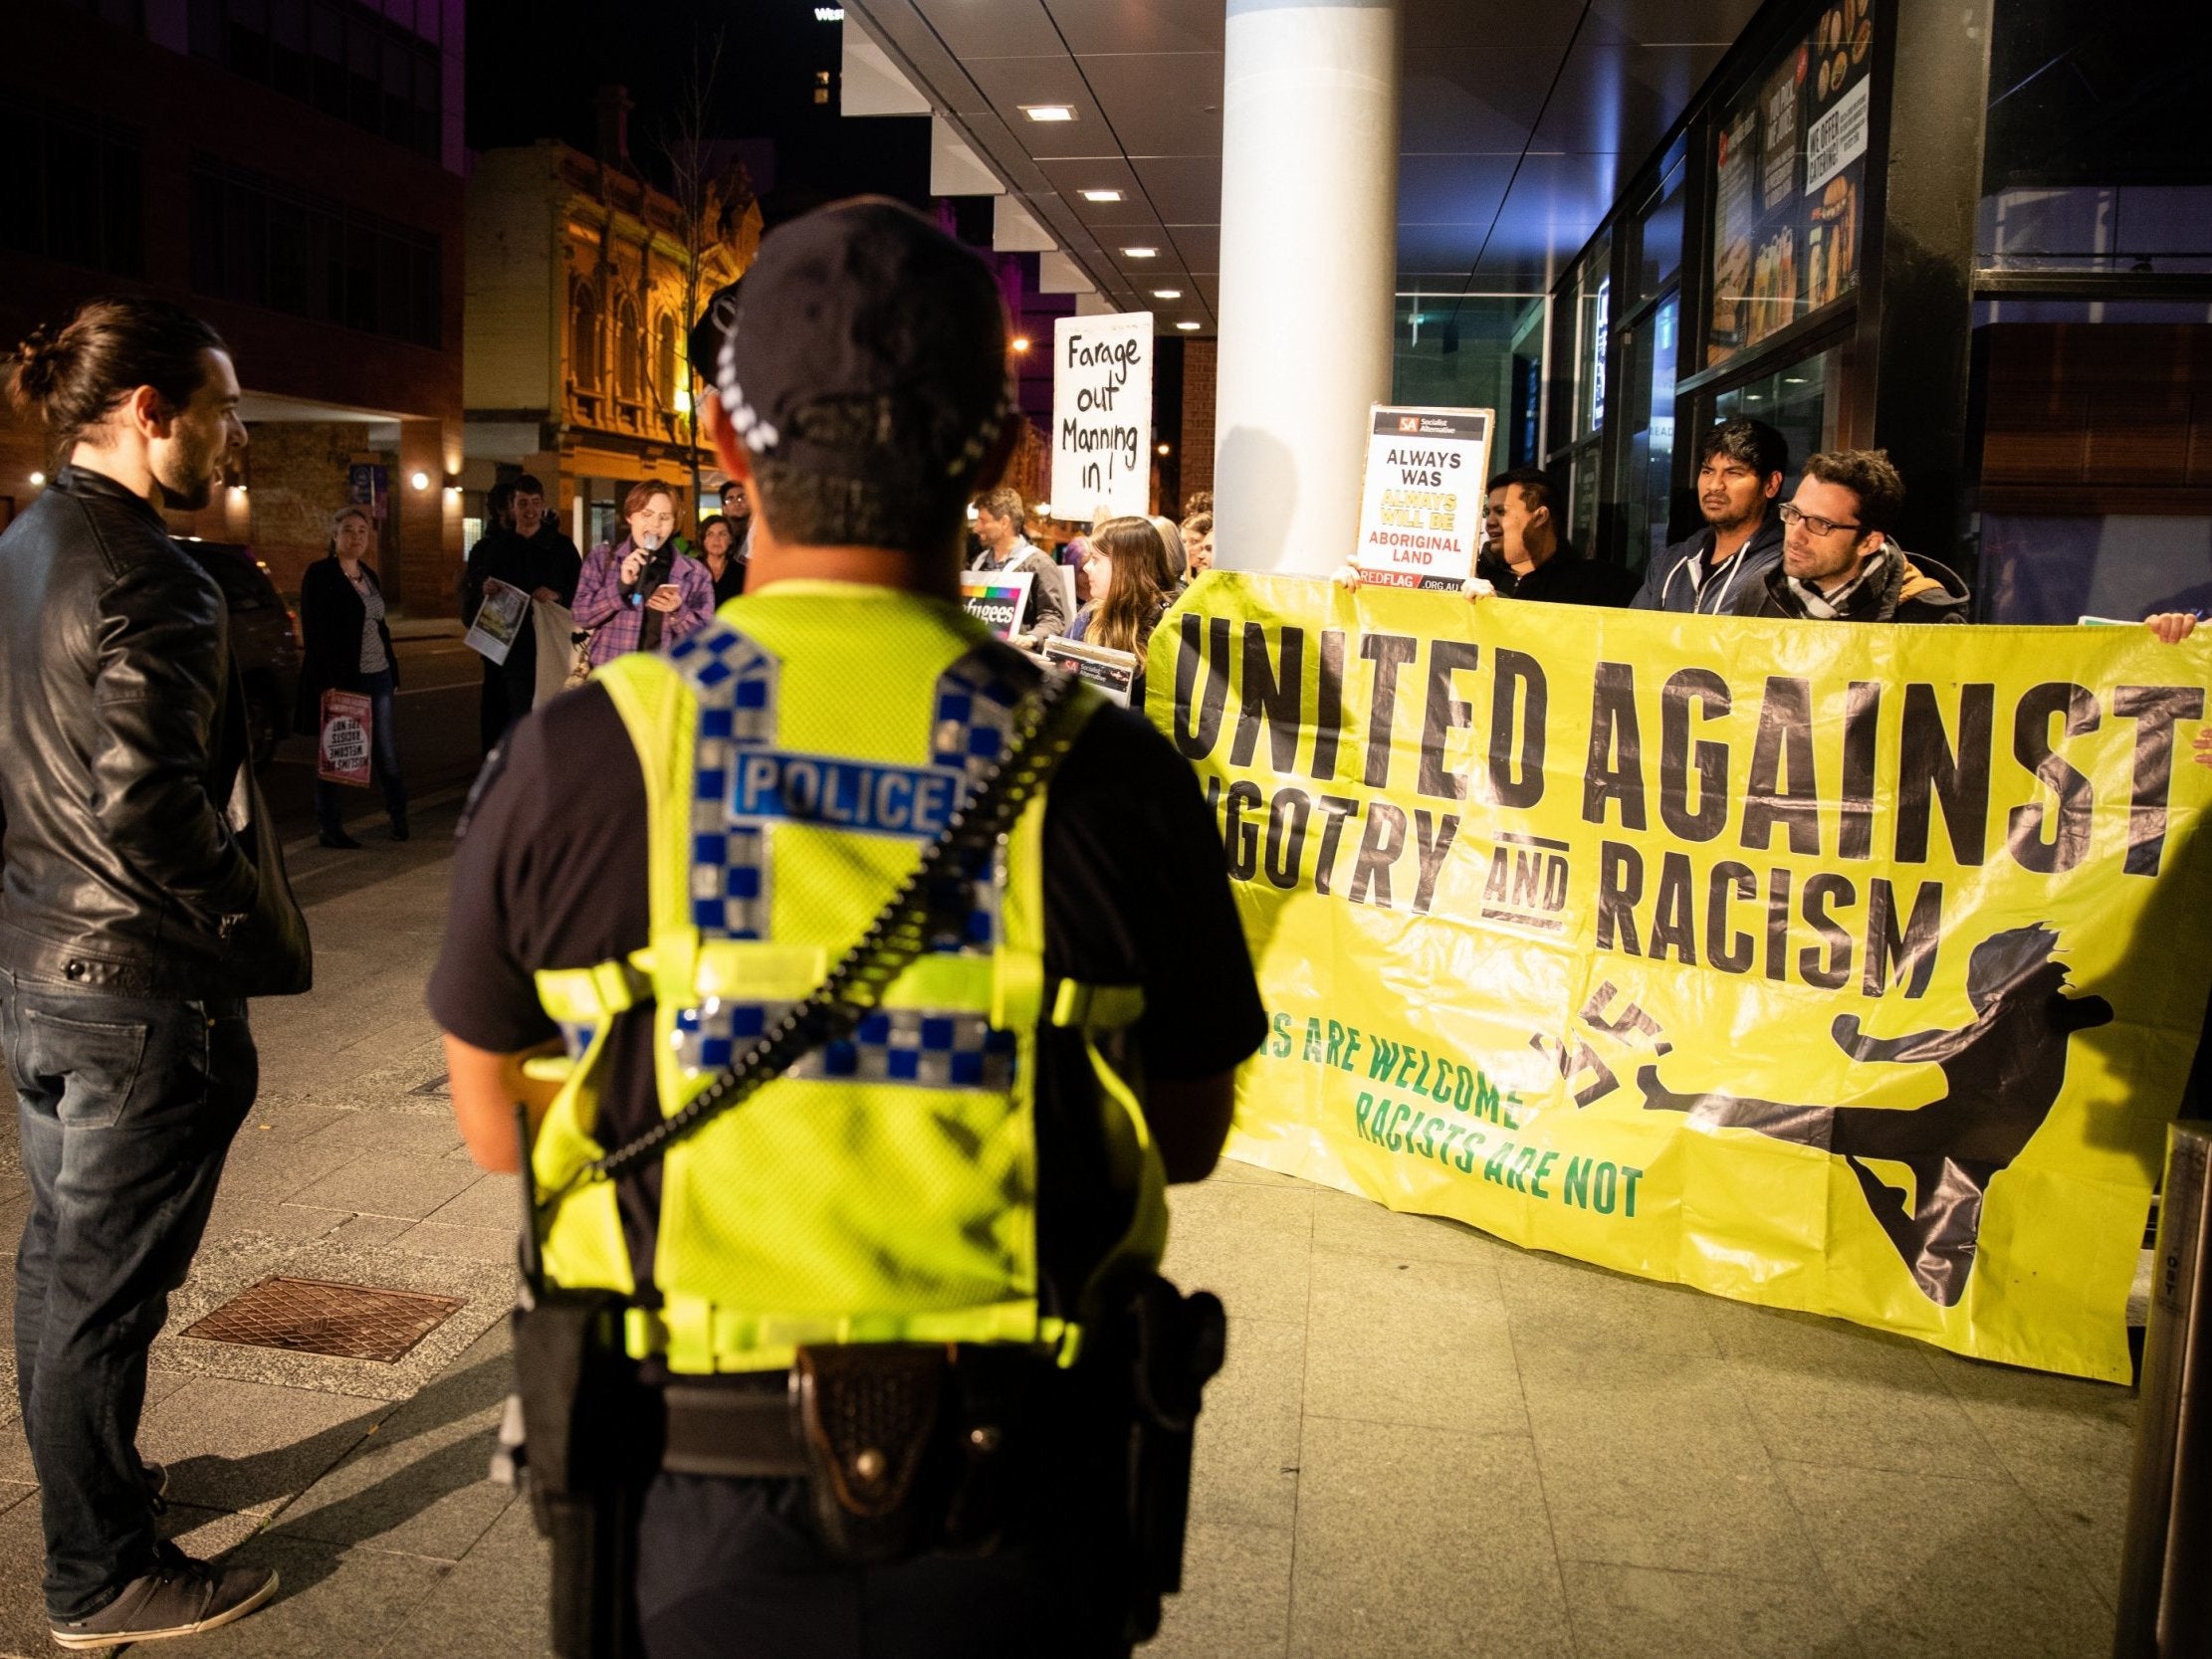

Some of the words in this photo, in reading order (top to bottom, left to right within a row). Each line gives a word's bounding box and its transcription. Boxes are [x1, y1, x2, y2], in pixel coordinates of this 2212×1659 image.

[1810, 127, 1820, 158] WE
[1820, 110, 1839, 149] OFFER
[1068, 334, 1141, 385] Farage
[1077, 369, 1120, 412] out
[1400, 418, 1418, 432] SA
[1420, 418, 1448, 427] Socialist
[1420, 425, 1456, 435] Alternative
[1062, 417, 1138, 472] Manning
[1386, 449, 1461, 470] ALWAYS
[1402, 469, 1442, 488] WAS
[1381, 489, 1457, 512] ALWAYS
[1380, 507, 1425, 528] WILL
[1430, 512, 1455, 531] BE
[1369, 531, 1461, 553] ABORIGINAL
[1393, 549, 1433, 565] LAND
[1360, 570, 1414, 588] REDFLAG
[332, 732, 361, 743] RACISTS
[1173, 612, 1549, 809] UNITED
[1582, 660, 2206, 878] AGAINST
[329, 744, 363, 759] WELCOME
[743, 756, 946, 833] POLICE
[1482, 846, 1570, 914] AND
[1596, 839, 1943, 999] RACISM
[1302, 1016, 1362, 1072] ARE
[1368, 1033, 1524, 1132] WELCOME
[1355, 1091, 1486, 1174] RACISTS
[1483, 1141, 1560, 1199] ARE
[1564, 1155, 1644, 1218] NOT
